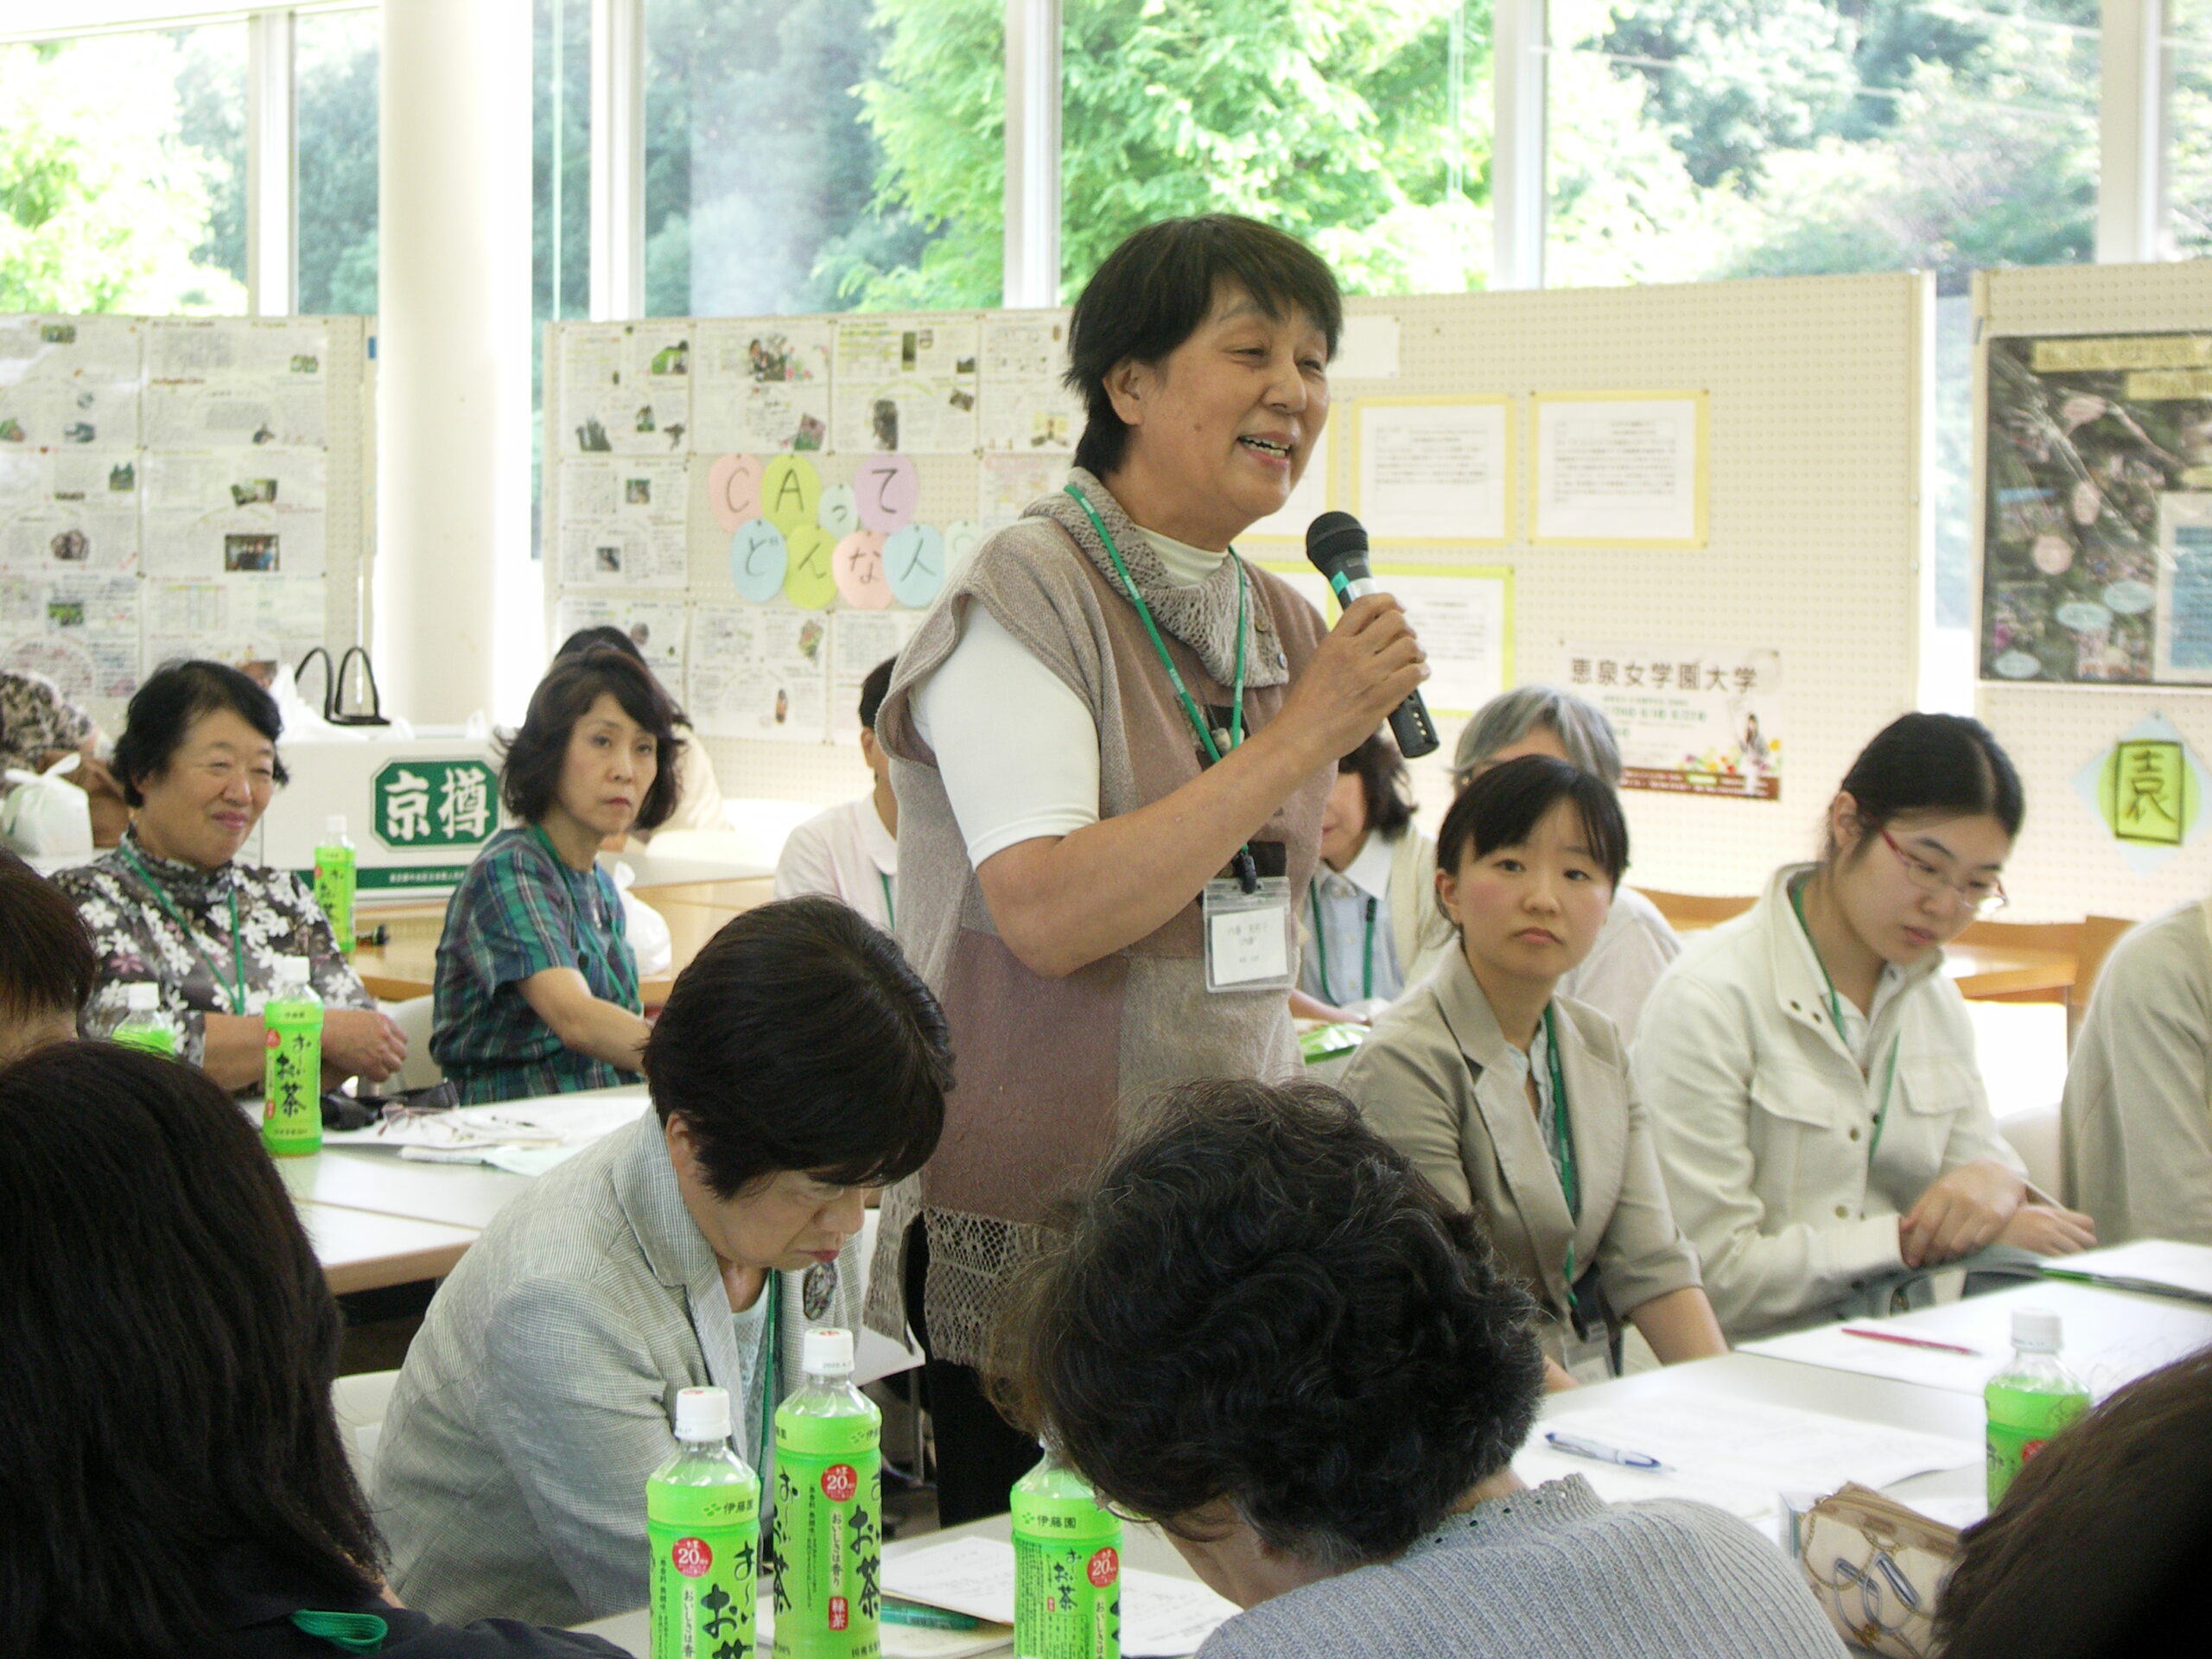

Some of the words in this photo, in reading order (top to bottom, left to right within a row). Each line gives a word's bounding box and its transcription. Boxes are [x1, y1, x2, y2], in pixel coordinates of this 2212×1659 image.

[1571, 658, 1758, 693] 恵泉女学園大学
[384, 766, 491, 841] 京樽
[1037, 1515, 1077, 1529] 伊藤園
[849, 1504, 880, 1620] お茶
[1053, 1562, 1078, 1611] お茶
